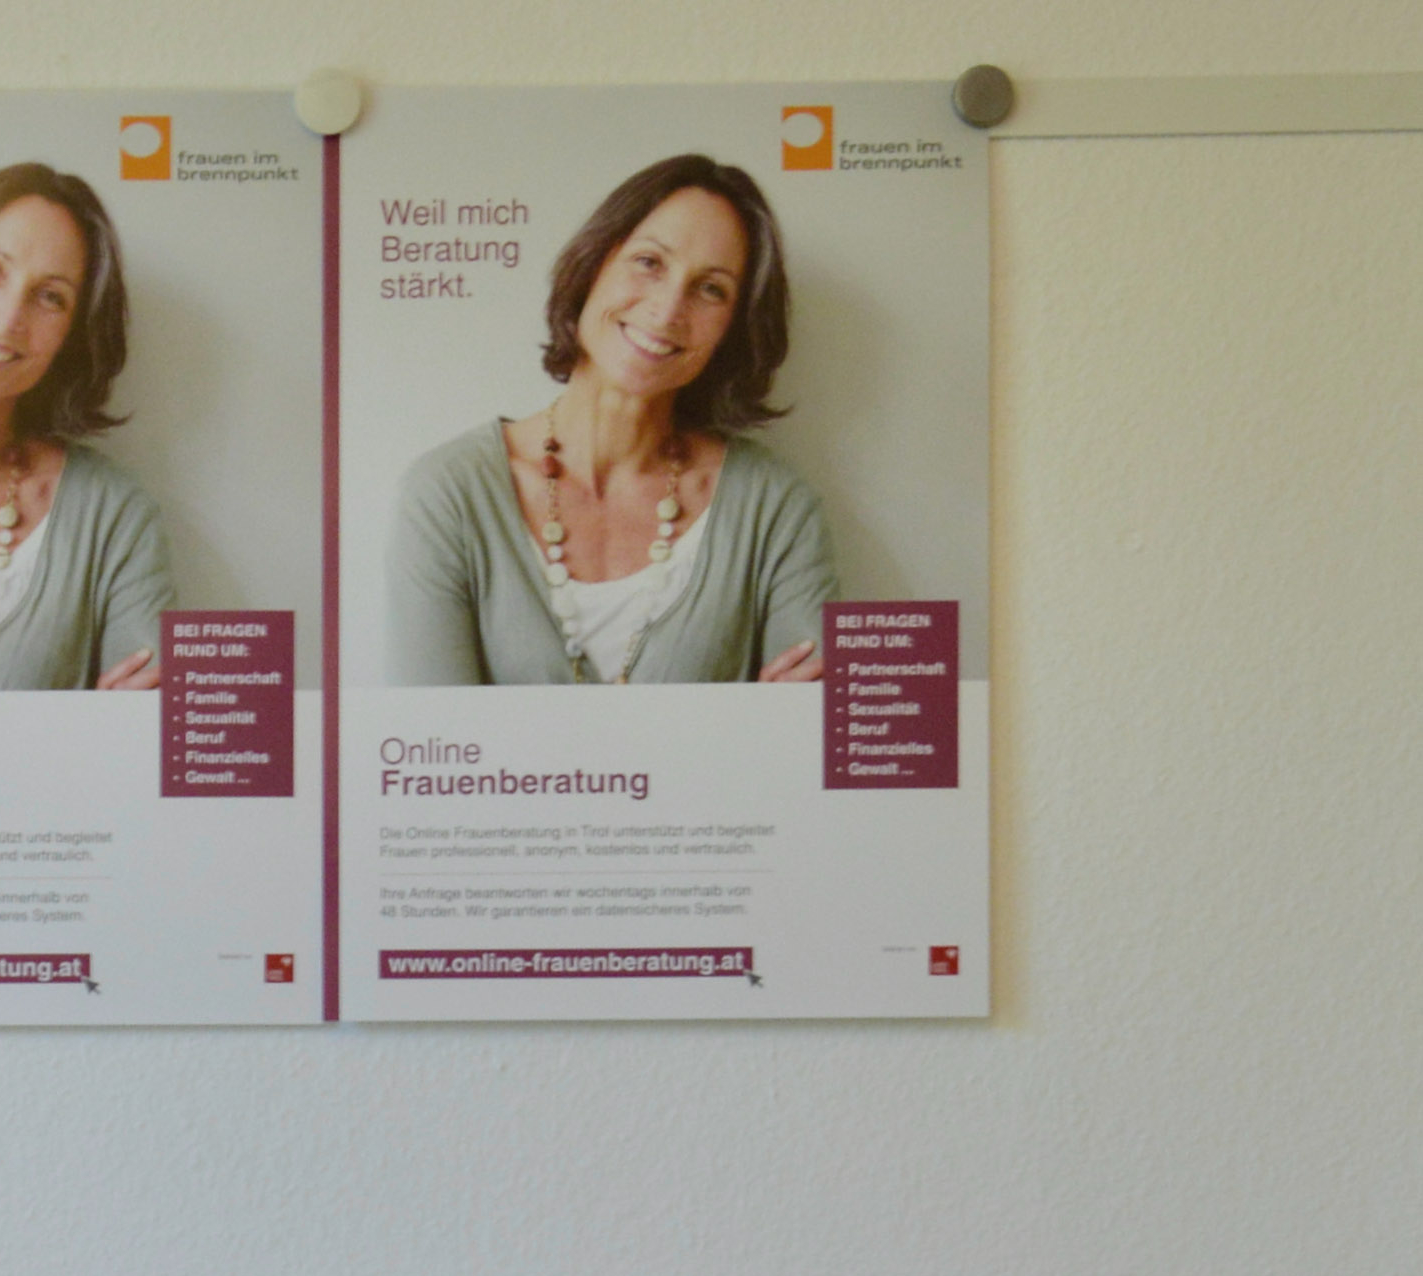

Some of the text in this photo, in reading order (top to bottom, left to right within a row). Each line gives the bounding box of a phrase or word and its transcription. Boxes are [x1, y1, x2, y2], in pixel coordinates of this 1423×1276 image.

[839, 139, 942, 155] frauen im
[178, 151, 279, 166] frauen im
[838, 154, 963, 172] brennpunkt
[176, 166, 300, 183] brennpunkt
[380, 197, 529, 226] Weil mich
[380, 234, 520, 267] Beratung
[379, 272, 473, 300] stärkt.
[836, 614, 931, 628] BEI FRAGEN
[173, 624, 268, 637] BEI FRAGEN
[836, 635, 913, 648] RUND UM:
[173, 644, 249, 657] RUND UM:
[379, 737, 482, 765] Online
[380, 769, 649, 800] Frauenberatung
[388, 950, 744, 976] www.online-frauenberatung.at
